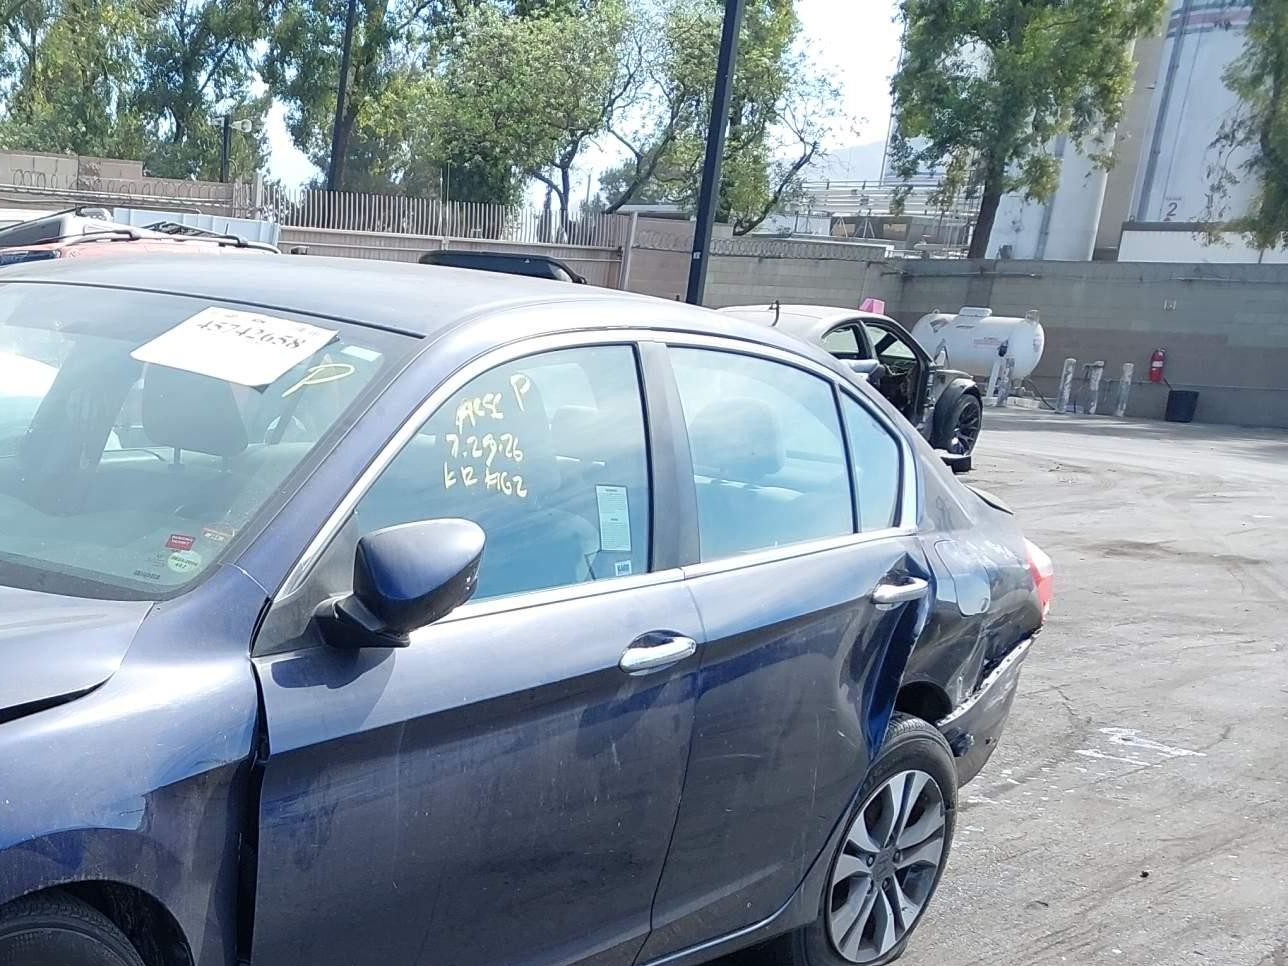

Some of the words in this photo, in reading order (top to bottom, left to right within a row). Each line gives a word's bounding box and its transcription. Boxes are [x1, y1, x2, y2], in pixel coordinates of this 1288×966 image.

[1166, 201, 1178, 217] 2
[281, 363, 355, 398] P
[510, 373, 531, 412] P
